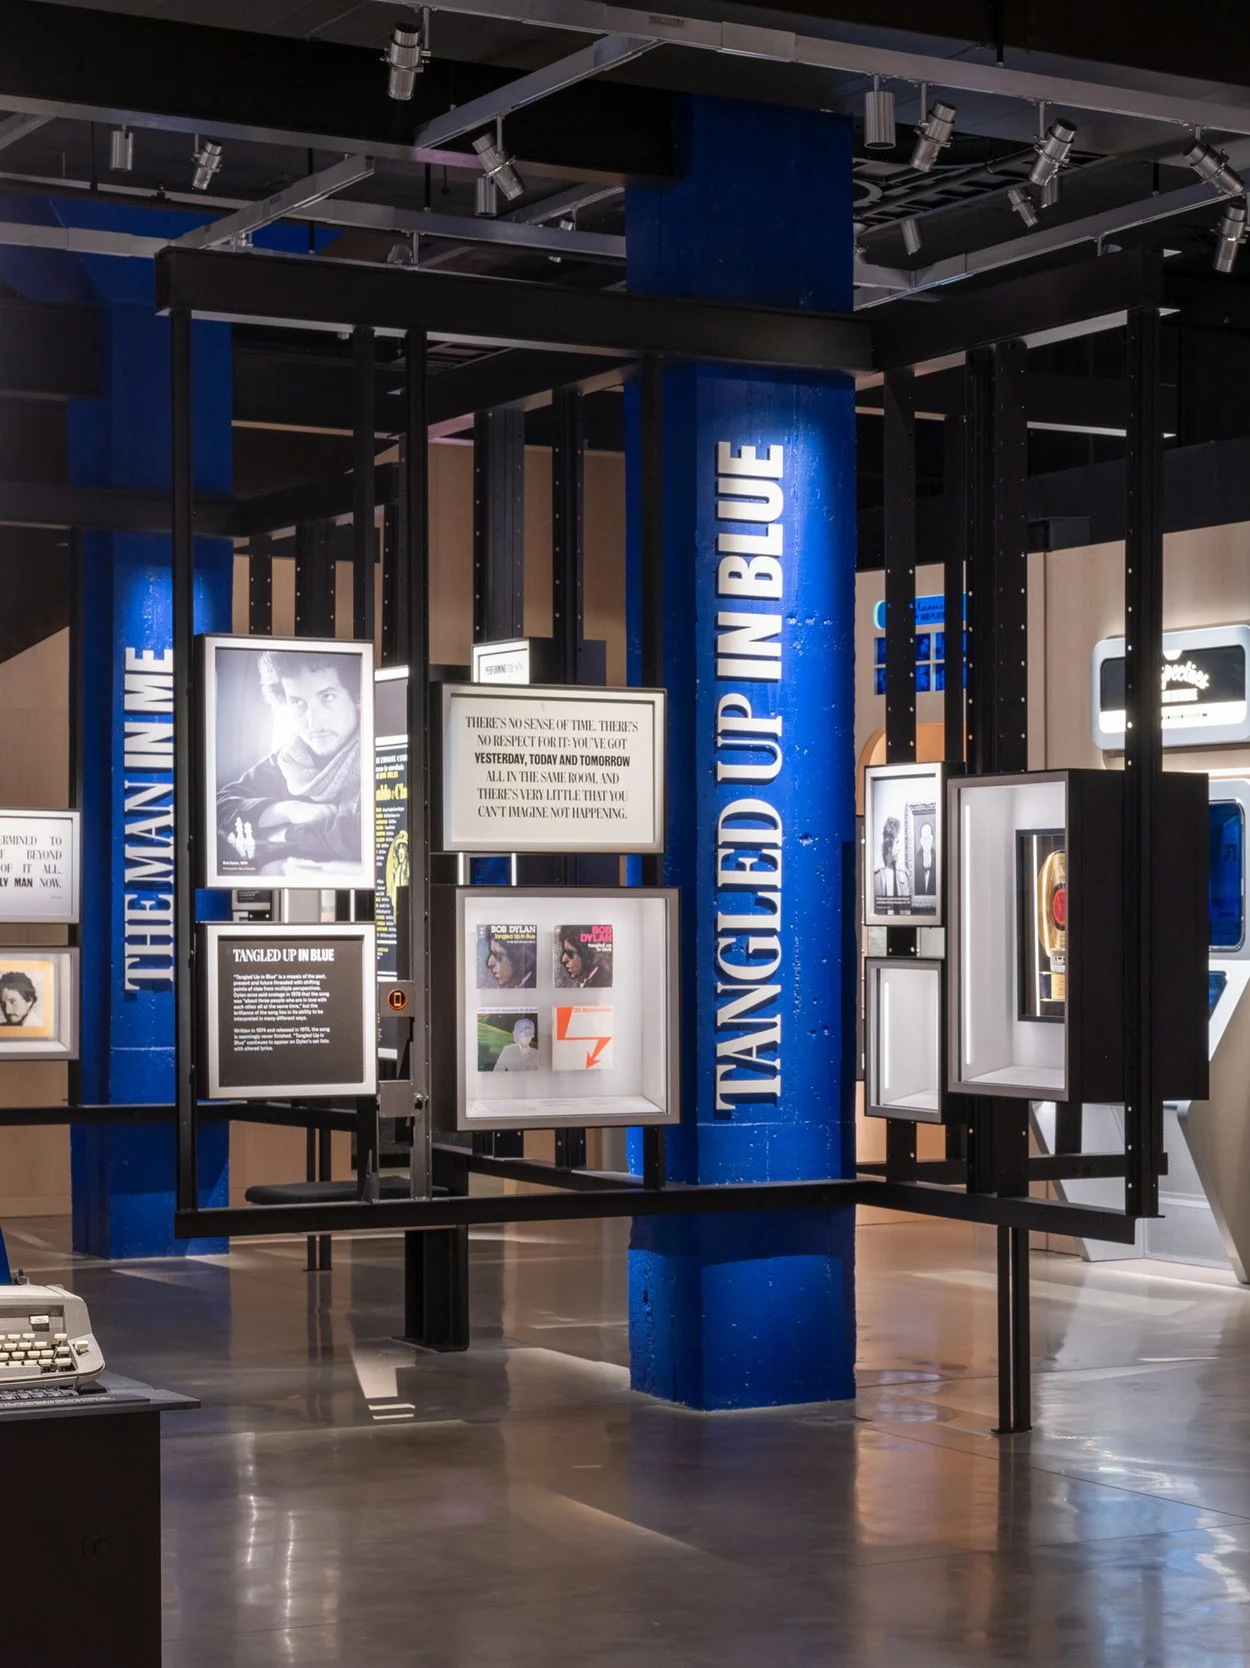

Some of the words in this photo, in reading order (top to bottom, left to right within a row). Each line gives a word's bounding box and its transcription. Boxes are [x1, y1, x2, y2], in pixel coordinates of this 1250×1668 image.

[716, 441, 782, 598] BLUE
[716, 611, 782, 678] IN
[124, 647, 174, 712] ME
[465, 716, 506, 728] THERE'S
[509, 718, 522, 728] NO
[524, 719, 554, 729] SENSE
[556, 720, 568, 730] OF
[600, 721, 638, 732] THERE'S
[478, 735, 491, 745] NO
[494, 735, 535, 746] RESPECT
[538, 737, 556, 747] FOR
[573, 738, 605, 748] YOU'VE
[608, 739, 626, 749] GOT
[716, 694, 782, 781] UP
[124, 722, 174, 768] IN
[475, 753, 527, 765] YESTERDAY,
[529, 754, 557, 764] TODAY
[560, 755, 578, 765] AND
[580, 756, 630, 766] TOMORROW
[487, 771, 504, 781] ALL
[507, 771, 516, 782] IN
[519, 772, 538, 782] THE
[541, 772, 566, 782] SAME
[602, 773, 619, 783] AND
[477, 788, 518, 799] THERE'S
[520, 789, 542, 800] VERY
[547, 790, 580, 800] LITTLE
[584, 790, 607, 801] THAT
[610, 791, 626, 801] YOU
[478, 806, 506, 817] CAN'T
[509, 807, 548, 817] IMAGINE
[551, 807, 570, 818] NOT
[573, 808, 627, 818] HAPPENING.
[124, 780, 174, 884] MAN
[50, 836, 62, 846] TO
[27, 850, 62, 860] BEYOND
[1, 863, 12, 873] OF
[23, 864, 32, 874] IT
[14, 878, 33, 888] MAN
[40, 879, 62, 888] NOW.
[124, 894, 174, 990] THE
[580, 934, 612, 942] DYLAN
[233, 949, 281, 961] TANGLED
[283, 949, 297, 961] UP
[298, 949, 309, 961] IN
[310, 949, 334, 961] BLUE
[716, 799, 782, 1110] TANGLED
